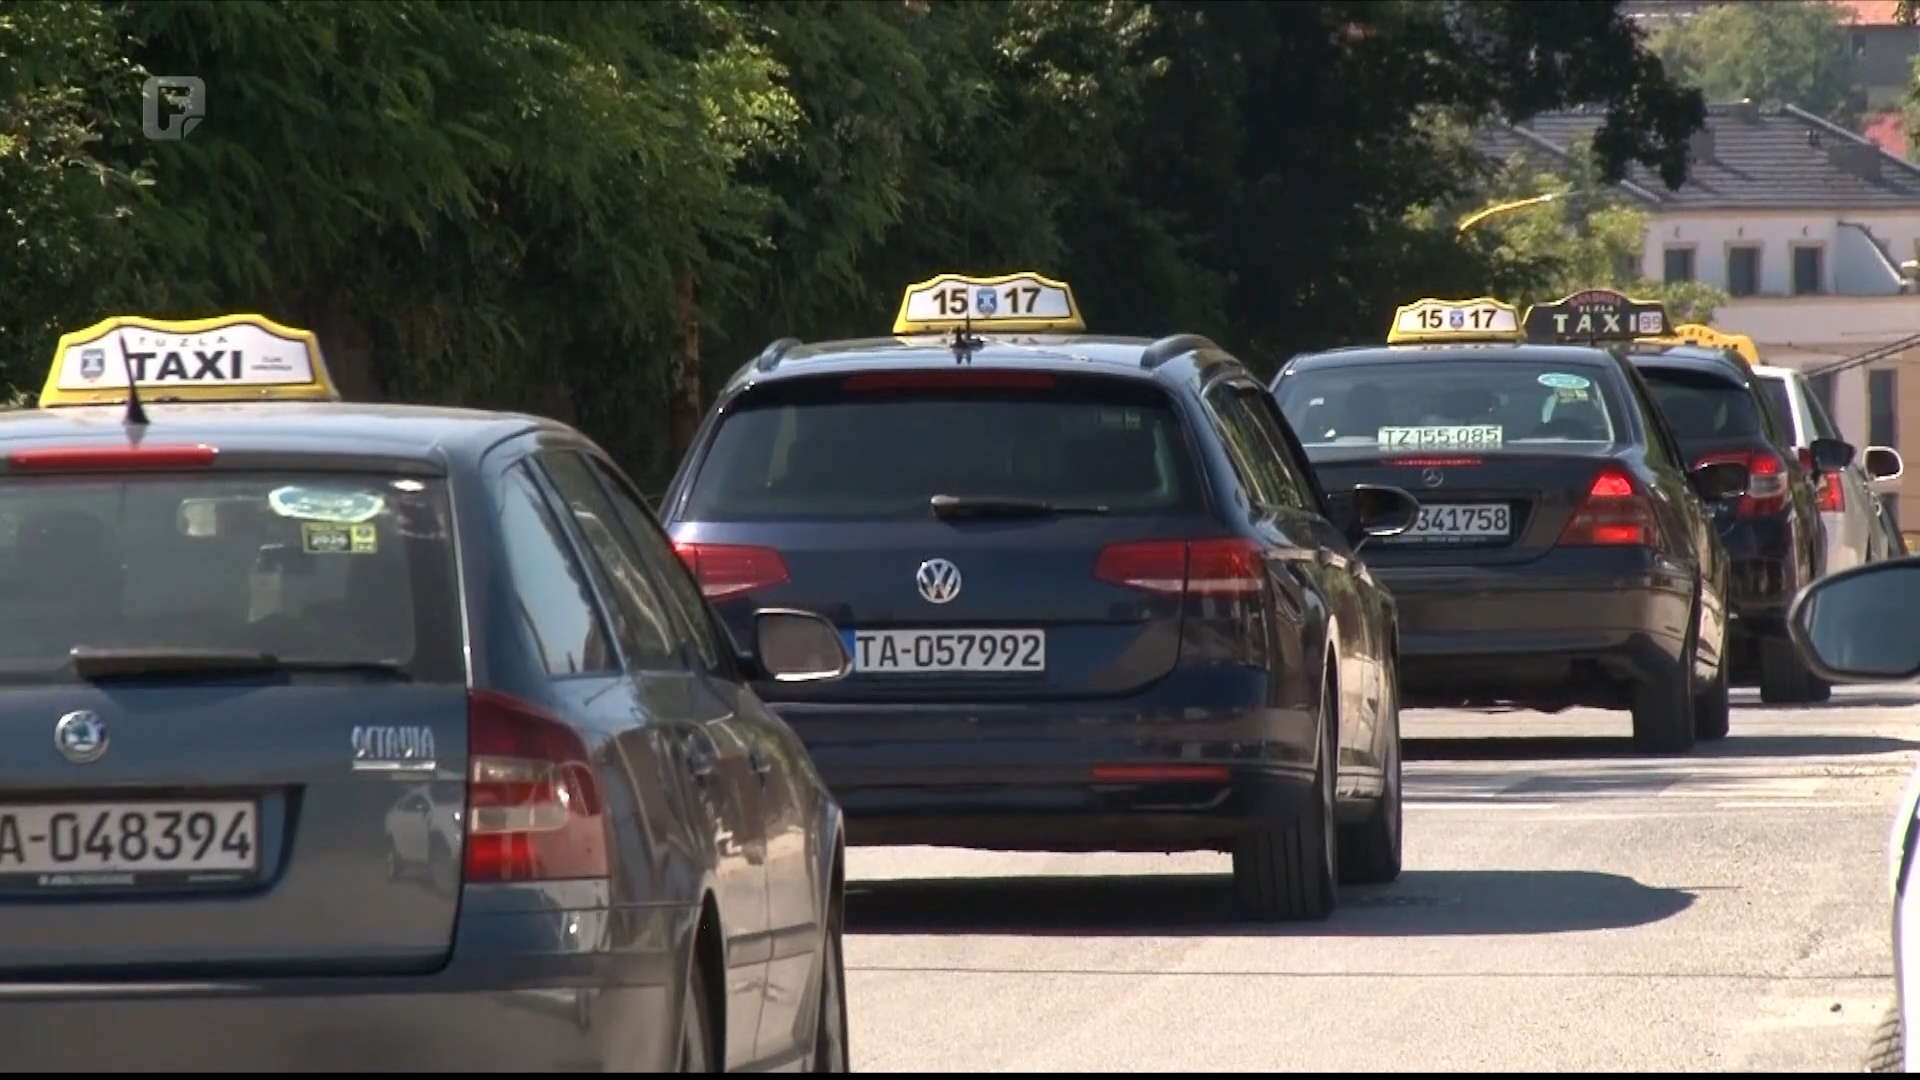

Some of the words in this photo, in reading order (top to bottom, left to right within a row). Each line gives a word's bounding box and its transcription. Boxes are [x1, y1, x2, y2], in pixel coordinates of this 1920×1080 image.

[932, 288, 969, 315] 15
[1004, 288, 1042, 314] 17
[1417, 309, 1443, 329] 15
[1469, 309, 1498, 329] 17
[1552, 313, 1637, 334] TAXI
[138, 335, 229, 348] TUZLA
[126, 349, 244, 382] TAXI
[856, 635, 1042, 668] TA-057992
[351, 726, 436, 759] OCTAVIA
